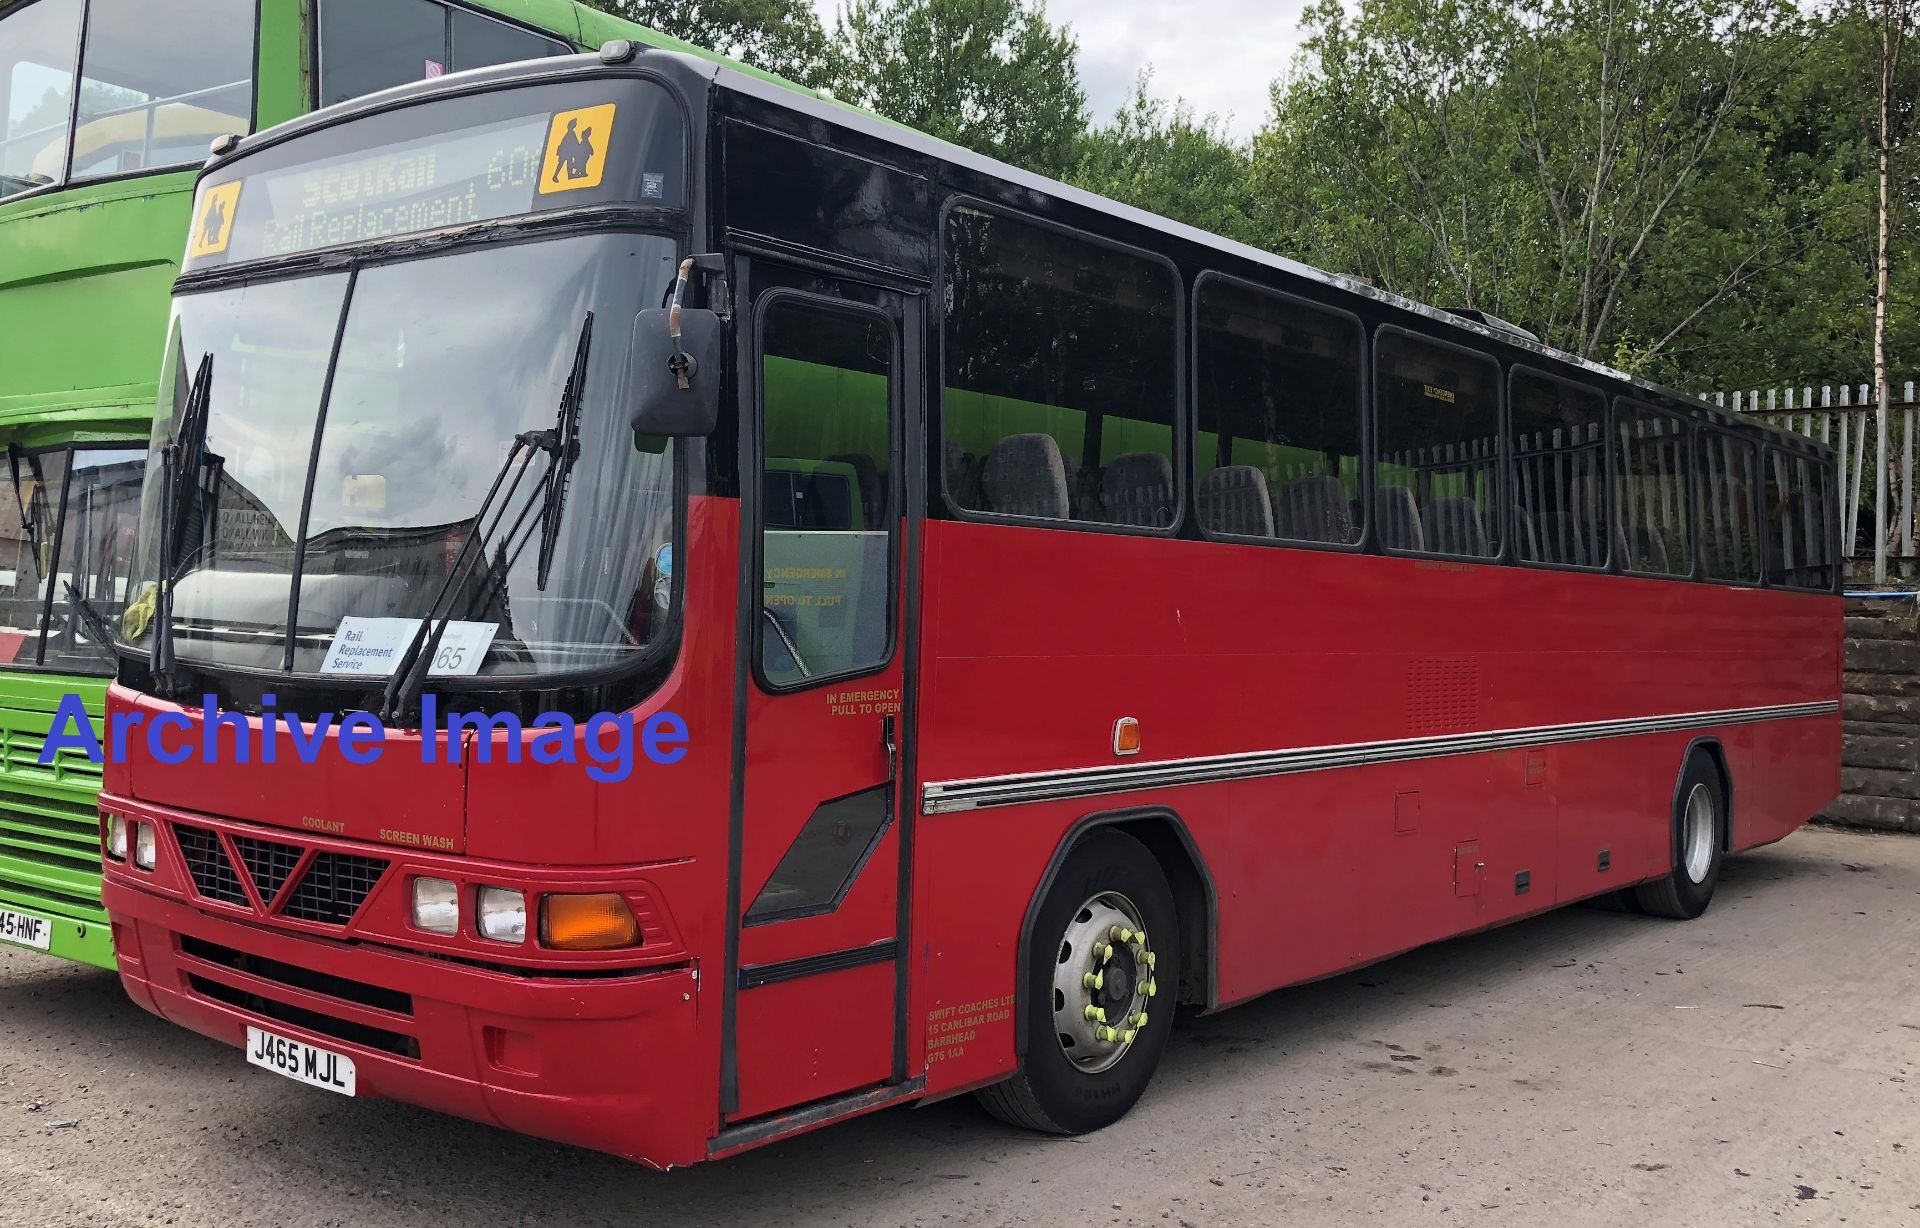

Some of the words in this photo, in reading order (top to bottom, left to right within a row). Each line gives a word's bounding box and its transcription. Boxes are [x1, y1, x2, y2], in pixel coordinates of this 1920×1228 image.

[311, 182, 479, 247] Replacement
[344, 630, 363, 642] Rail
[339, 644, 393, 660] Replacement
[332, 657, 363, 670] Service
[826, 693, 837, 704] IN
[840, 689, 900, 703] EMERGENCY
[831, 705, 857, 716] PULL
[860, 703, 872, 714] TO
[875, 702, 900, 713] OPEN
[302, 815, 345, 833] COOLANT
[380, 828, 420, 845] SCREEN
[422, 835, 454, 850] WASH
[17, 915, 42, 941] HNF
[928, 1006, 956, 1021] SWIFT
[959, 998, 999, 1014] COACHES
[928, 1024, 939, 1035] 15
[941, 1014, 984, 1032] CARLIBAR
[987, 1009, 1010, 1023] ROAD
[928, 1030, 976, 1049] BARRHEAD
[254, 1031, 299, 1073] J465
[305, 1047, 345, 1088] MJL
[947, 1046, 965, 1059] 1AA
